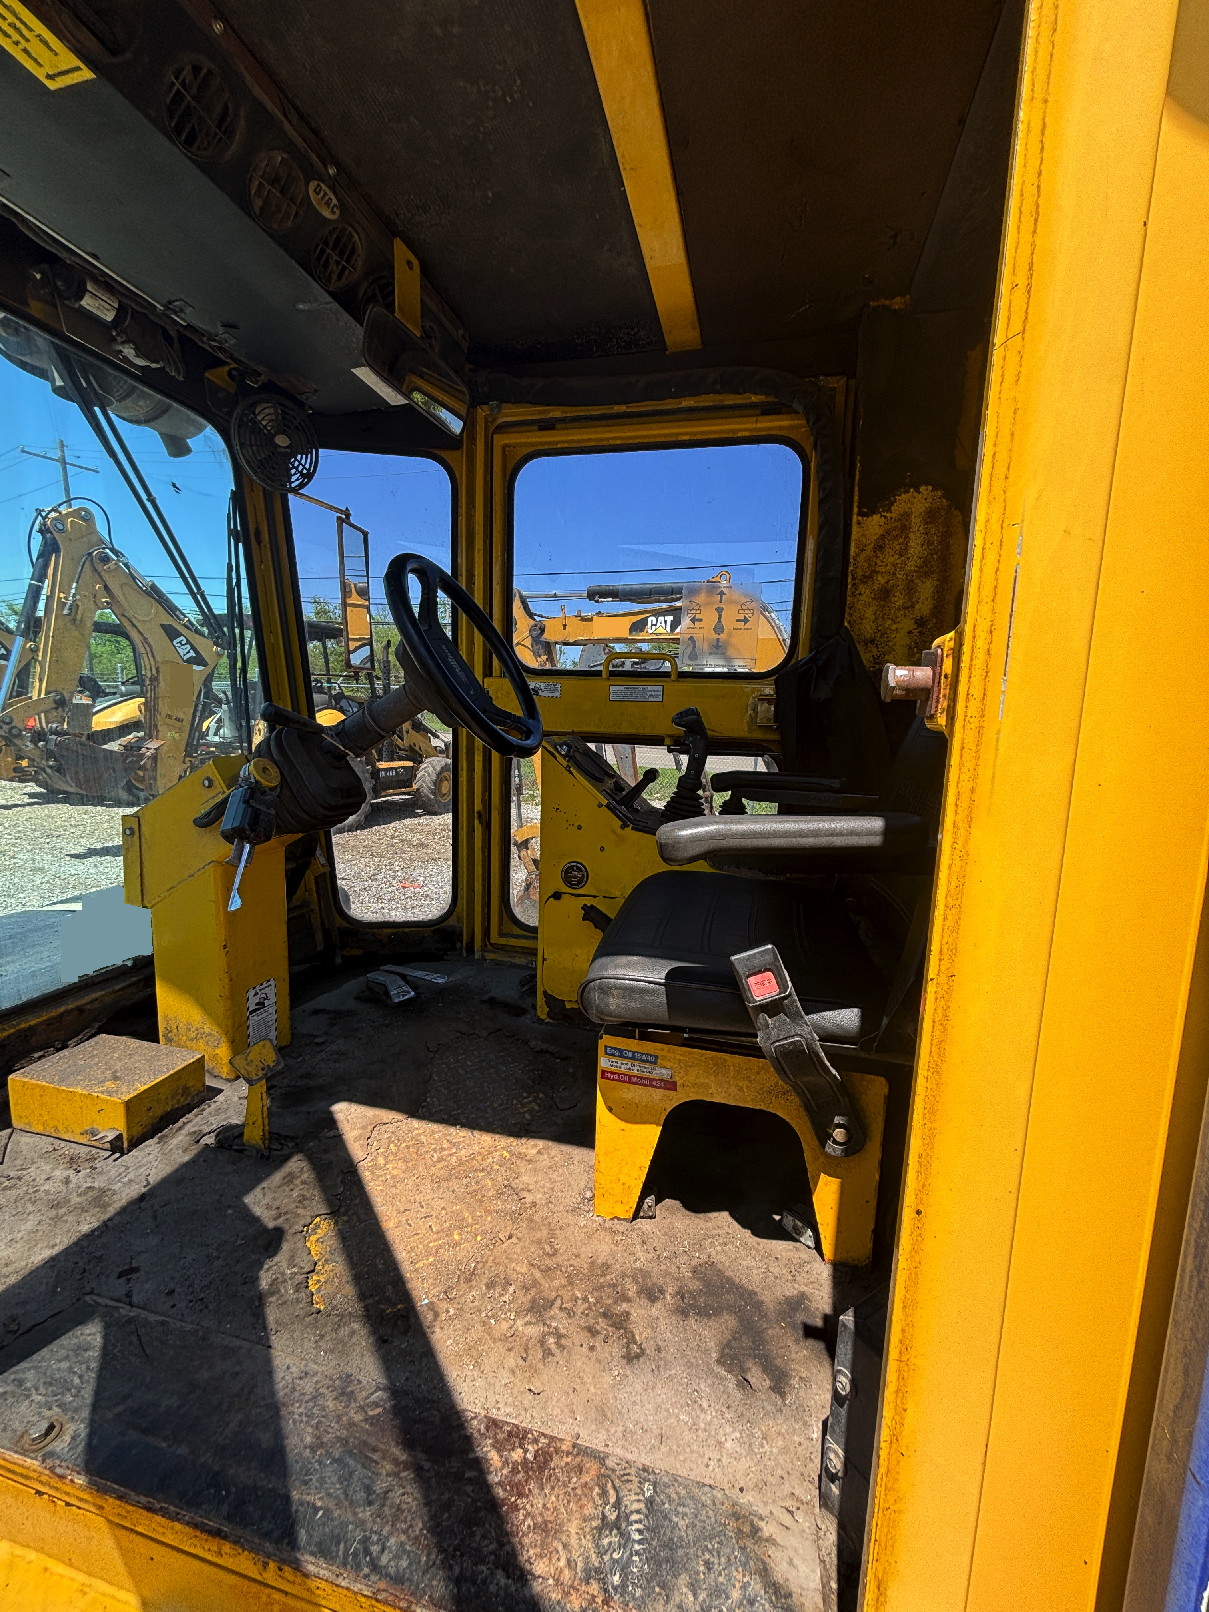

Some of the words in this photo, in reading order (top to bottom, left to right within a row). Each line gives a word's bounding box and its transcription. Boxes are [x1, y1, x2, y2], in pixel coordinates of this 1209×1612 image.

[313, 183, 339, 215] DTAC
[647, 616, 674, 635] CAT
[172, 635, 197, 661] CAT
[606, 1047, 621, 1056] Eng.
[622, 1050, 633, 1058] Oil
[631, 1076, 650, 1085] Mobil
